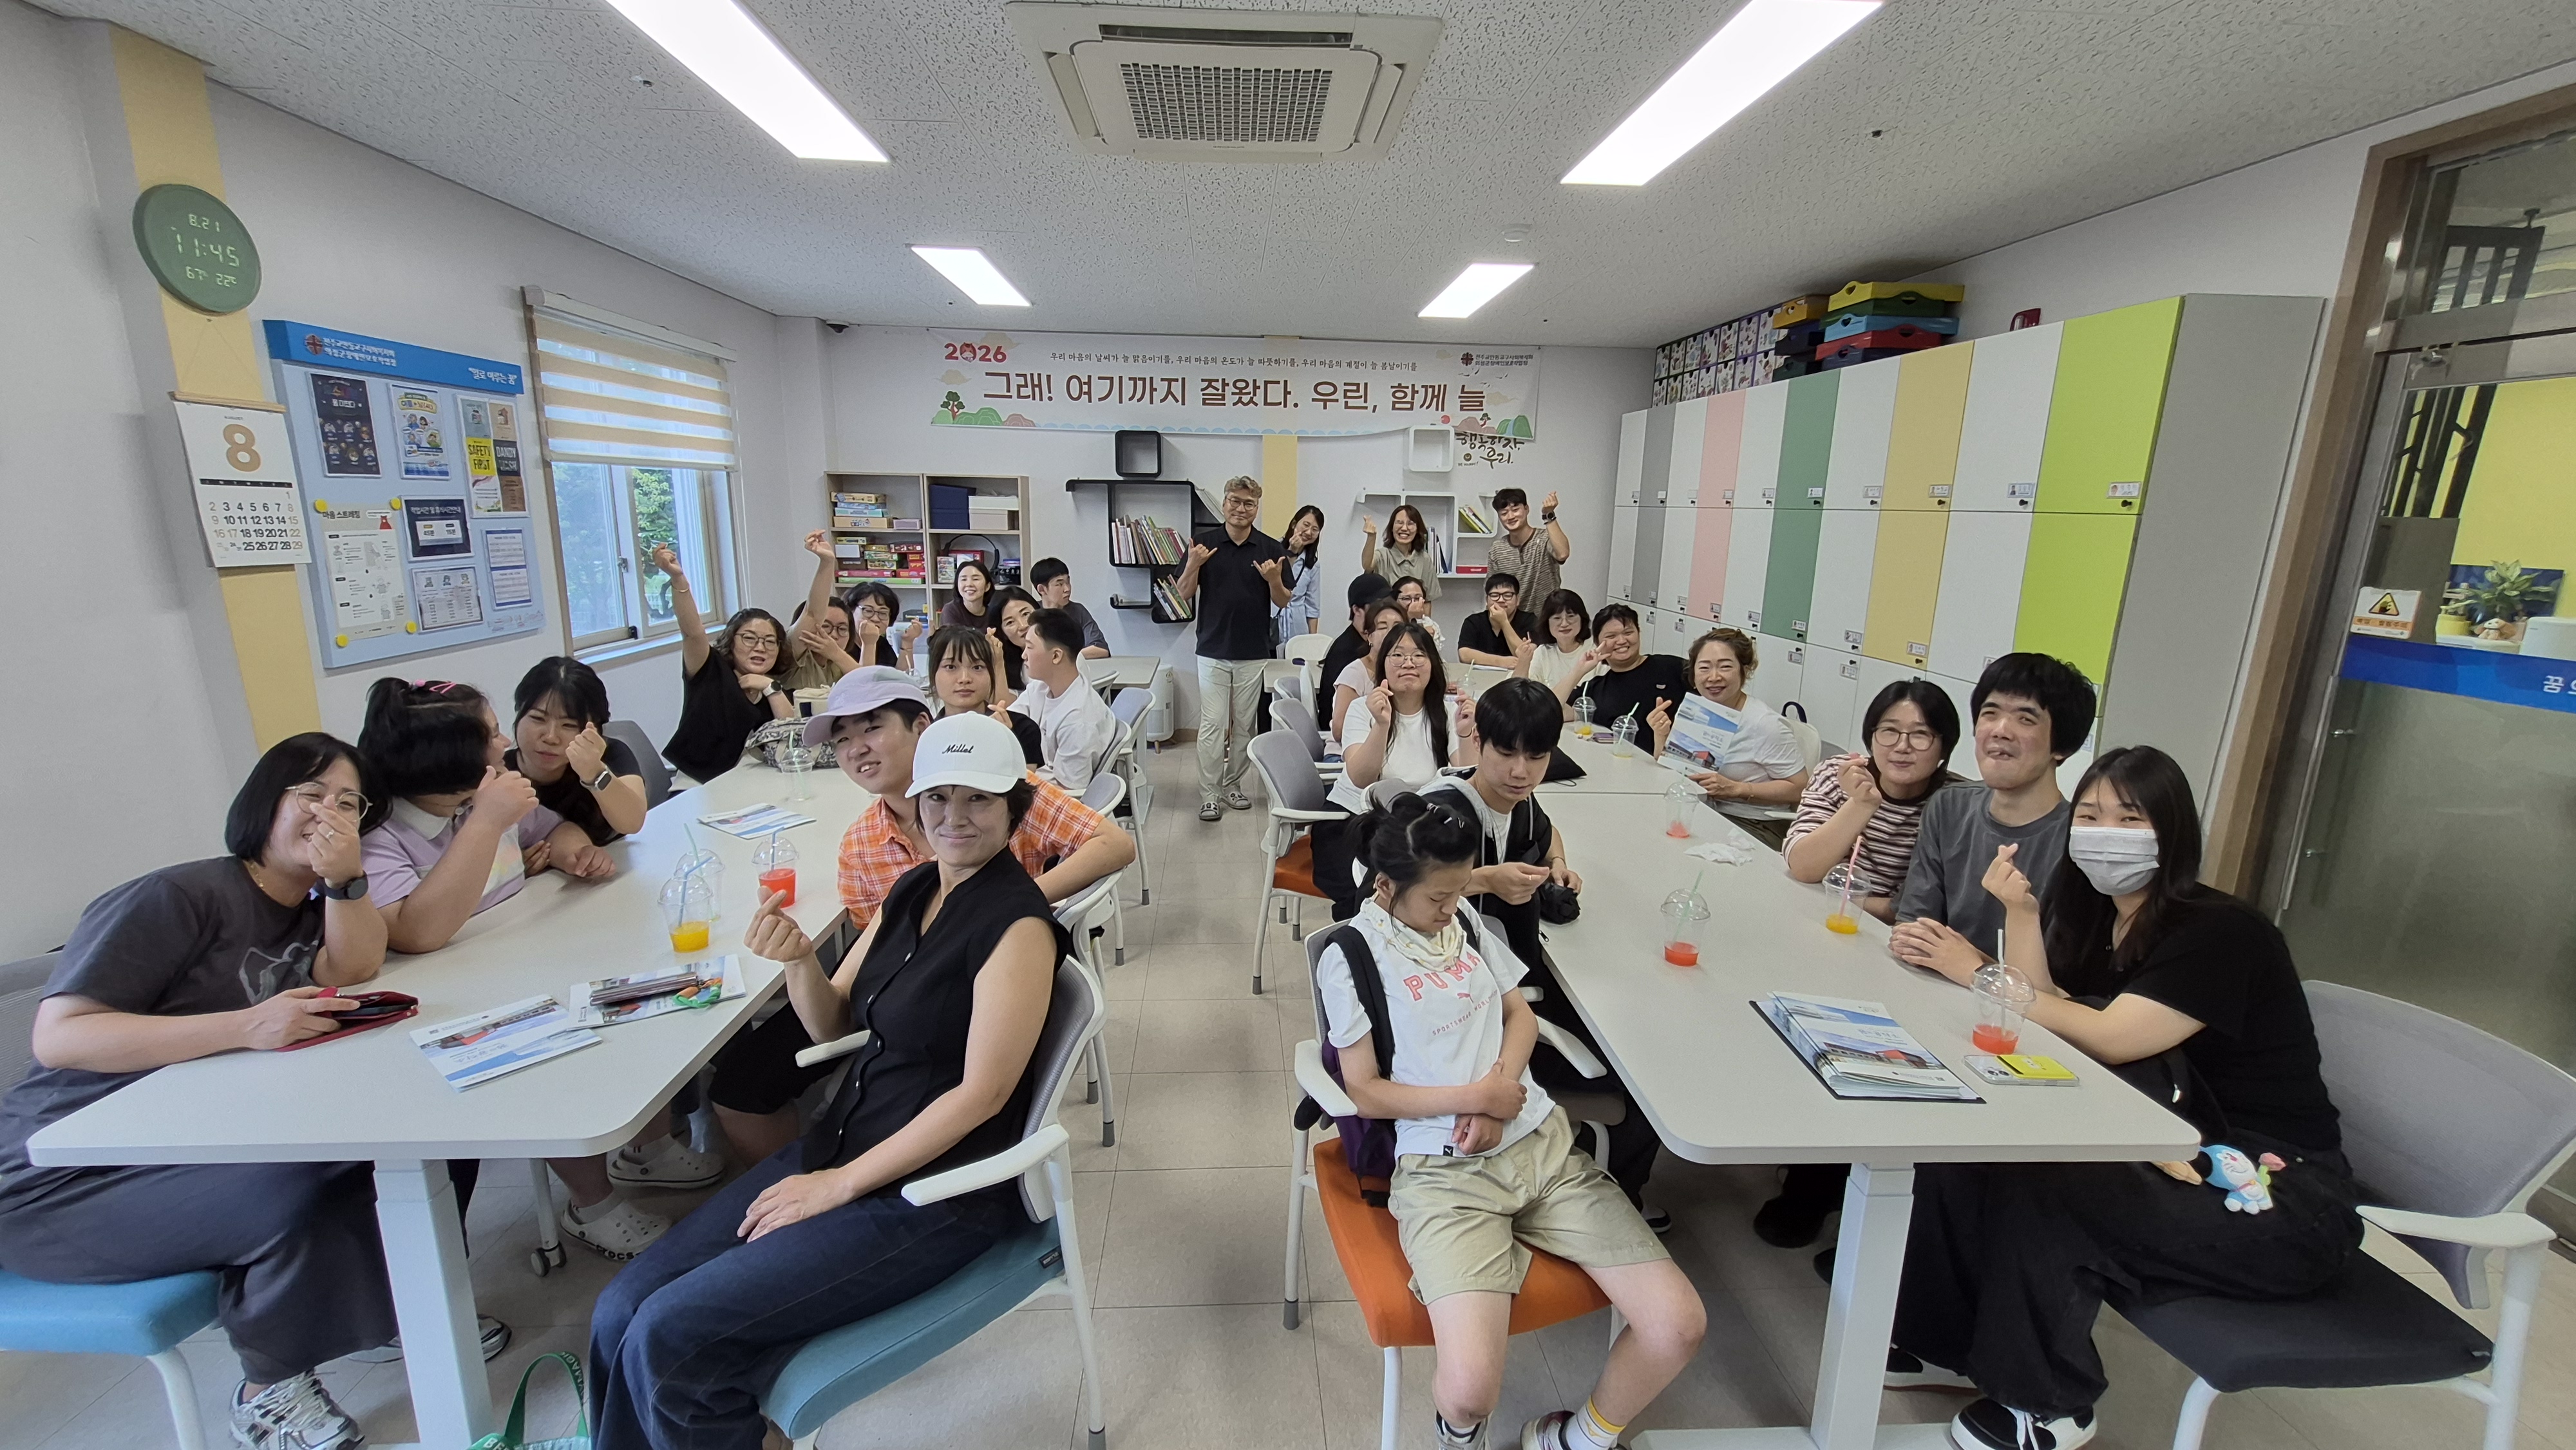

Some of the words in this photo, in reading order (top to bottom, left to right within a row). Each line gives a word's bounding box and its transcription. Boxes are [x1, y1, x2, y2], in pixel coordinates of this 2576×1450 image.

[1050, 352, 1066, 361] 우리
[1068, 353, 1092, 362] 마음의
[1095, 353, 1119, 362] 날씨가
[1121, 354, 1130, 362] 늘
[1132, 354, 1174, 364] 맑음이기를,
[1176, 355, 1191, 364] 우리
[1195, 356, 1218, 365] 마음의
[1221, 356, 1244, 366] 온도가
[1247, 357, 1255, 366] 늘
[1258, 357, 1299, 368] 따뜻하기를,
[1302, 359, 1317, 368] 우리
[1320, 359, 1342, 369] 마음의
[1370, 361, 1378, 370] 늘
[1381, 361, 1417, 372] 봄날이기를
[983, 372, 1054, 402] 그래!
[1066, 375, 1186, 406] 여기까지
[1200, 377, 1299, 409] 잘왔다.
[1311, 381, 1378, 413] 우린,
[1390, 383, 1448, 412] 함께
[1458, 384, 1485, 412] 늘
[223, 423, 261, 473] 8
[468, 444, 491, 457] SAFETY
[473, 459, 491, 471] FIRST
[209, 502, 216, 511] 2
[222, 502, 231, 511] 3
[237, 502, 243, 511] 4
[250, 503, 257, 512] 5
[262, 503, 269, 512] 6
[274, 503, 281, 512] 7
[211, 516, 219, 525] 9
[223, 516, 235, 525] 10
[237, 516, 248, 525] 11
[250, 516, 261, 525] 12
[263, 516, 274, 525] 13
[276, 516, 287, 525] 14
[288, 516, 298, 525] 15
[240, 529, 251, 538] 18
[253, 529, 264, 538] 19
[265, 529, 277, 538] 20
[278, 529, 289, 538] 21
[290, 529, 301, 537] 22
[243, 541, 255, 551] 25
[255, 541, 267, 551] 26
[268, 541, 279, 551] 27
[279, 541, 292, 550] 28
[292, 541, 303, 550] 29
[1403, 951, 1481, 1001] PUMA
